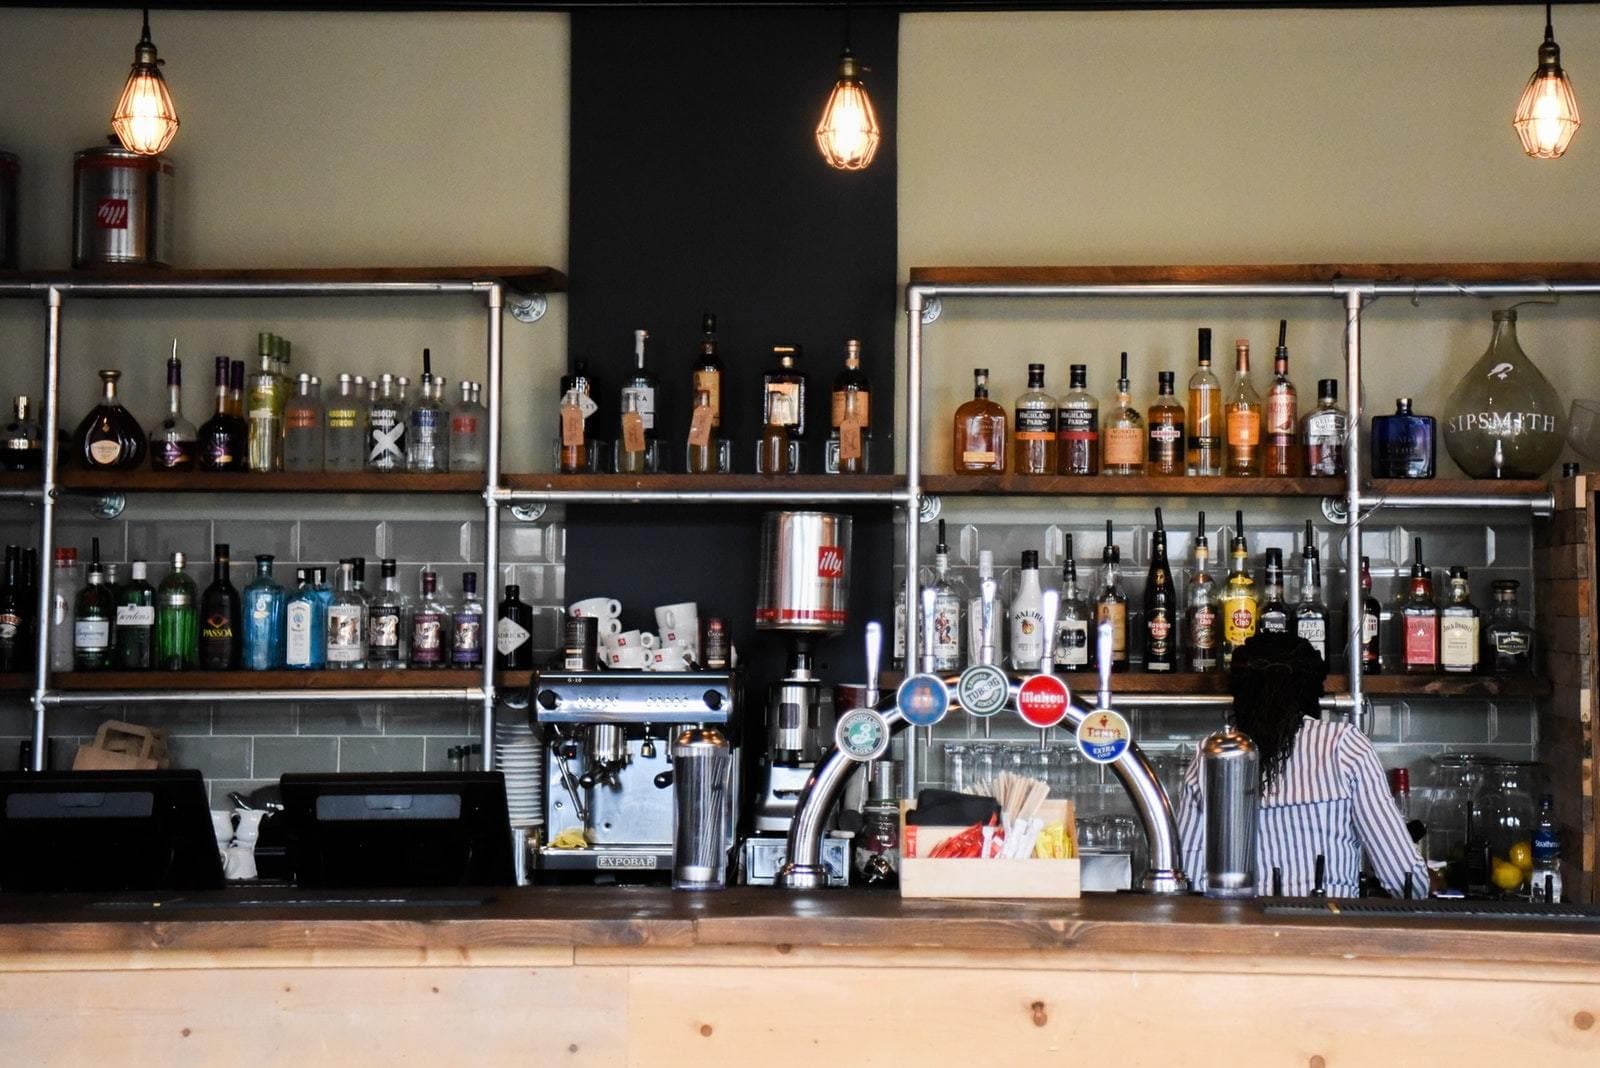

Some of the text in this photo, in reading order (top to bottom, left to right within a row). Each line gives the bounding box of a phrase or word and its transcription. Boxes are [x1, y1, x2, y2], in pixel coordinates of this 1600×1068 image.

[1448, 411, 1555, 434] SIPSMITH
[819, 551, 842, 575] illy
[1021, 691, 1065, 704] Mahou
[1092, 745, 1116, 755] EXTRA
[599, 858, 654, 867] EXPOBAR
